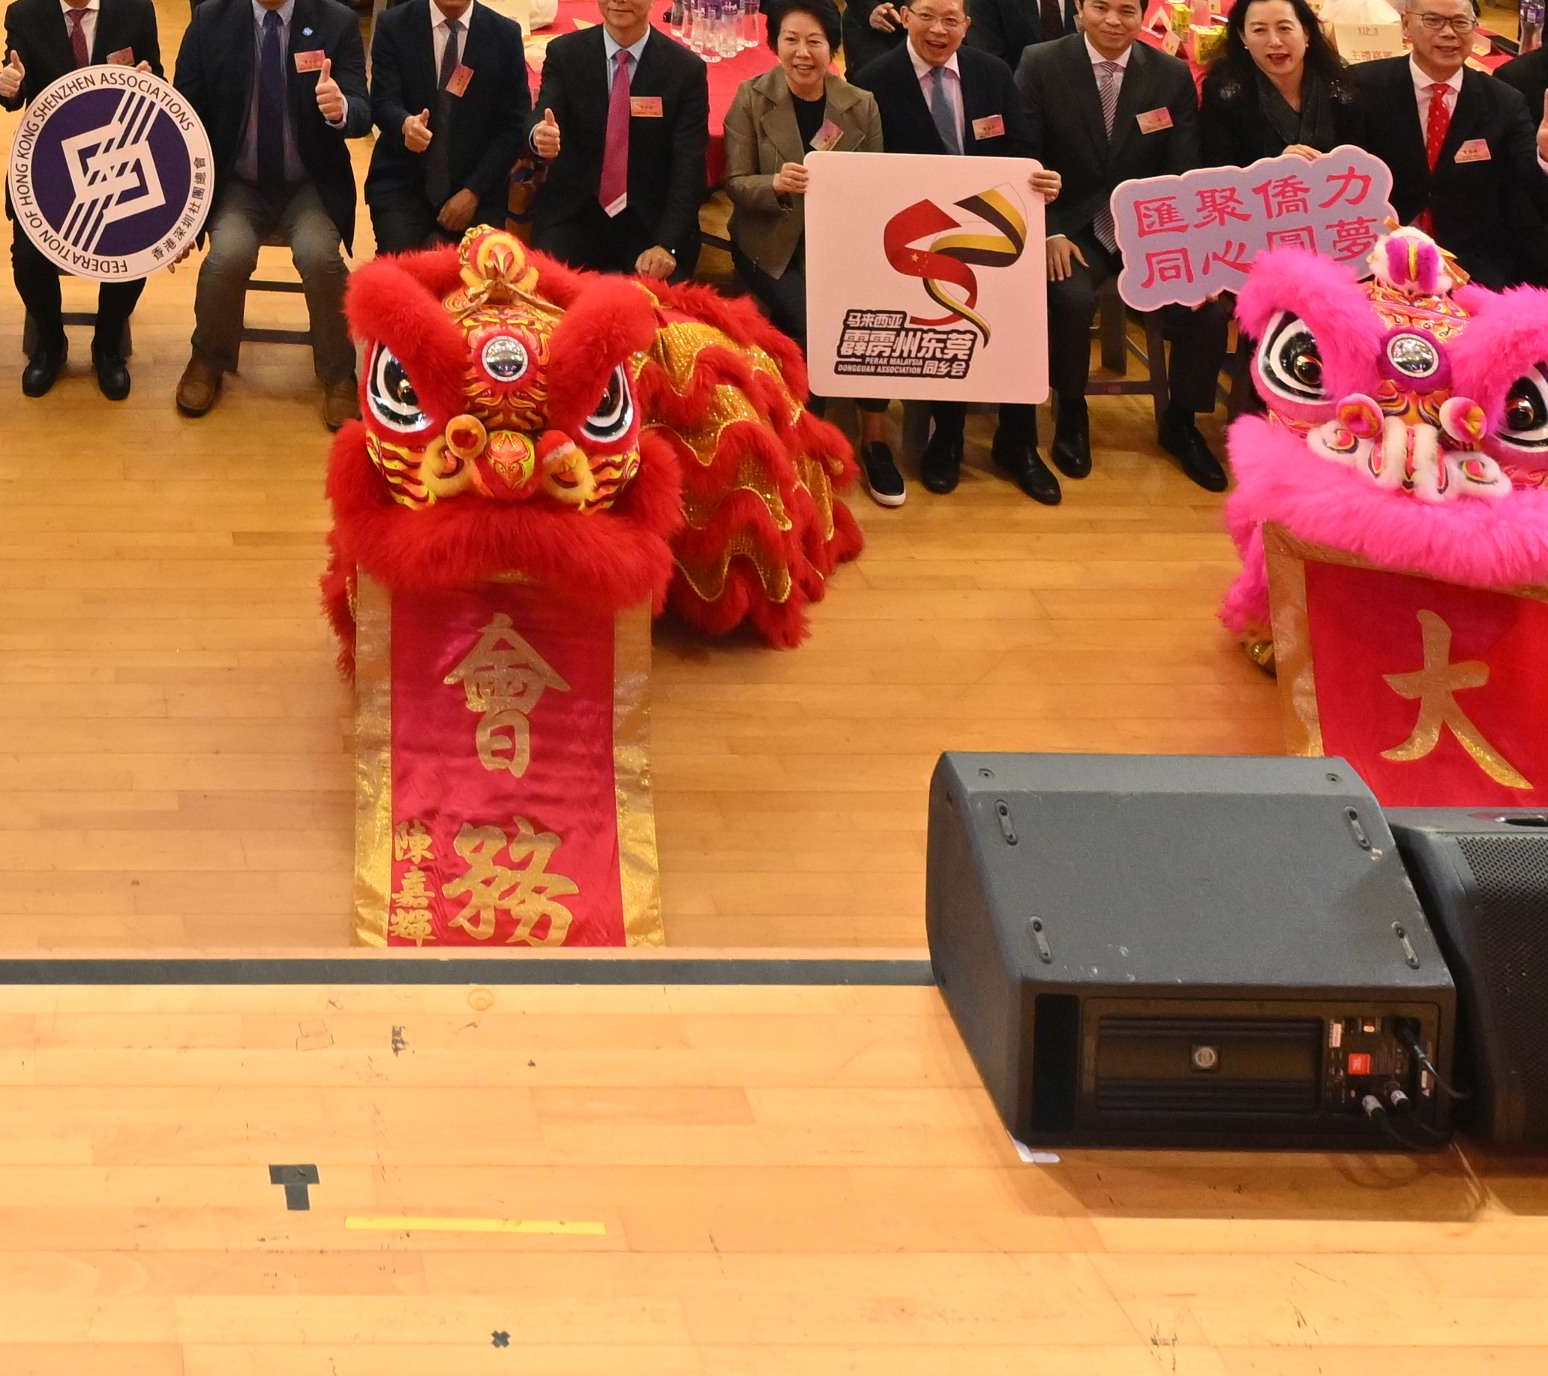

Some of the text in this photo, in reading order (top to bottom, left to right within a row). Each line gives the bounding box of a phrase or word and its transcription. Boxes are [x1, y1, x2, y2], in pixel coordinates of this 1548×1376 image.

[15, 73, 195, 273] FEDERATION OF HONG KONG SHENZHEN ASSOCIATIONS
[1132, 166, 1372, 238] 匯聚僑力
[846, 312, 904, 328] 马来西亚
[865, 357, 923, 366] PERAK MALAYSIA
[876, 365, 922, 375] ASSOCIATION
[1380, 609, 1534, 789] 大
